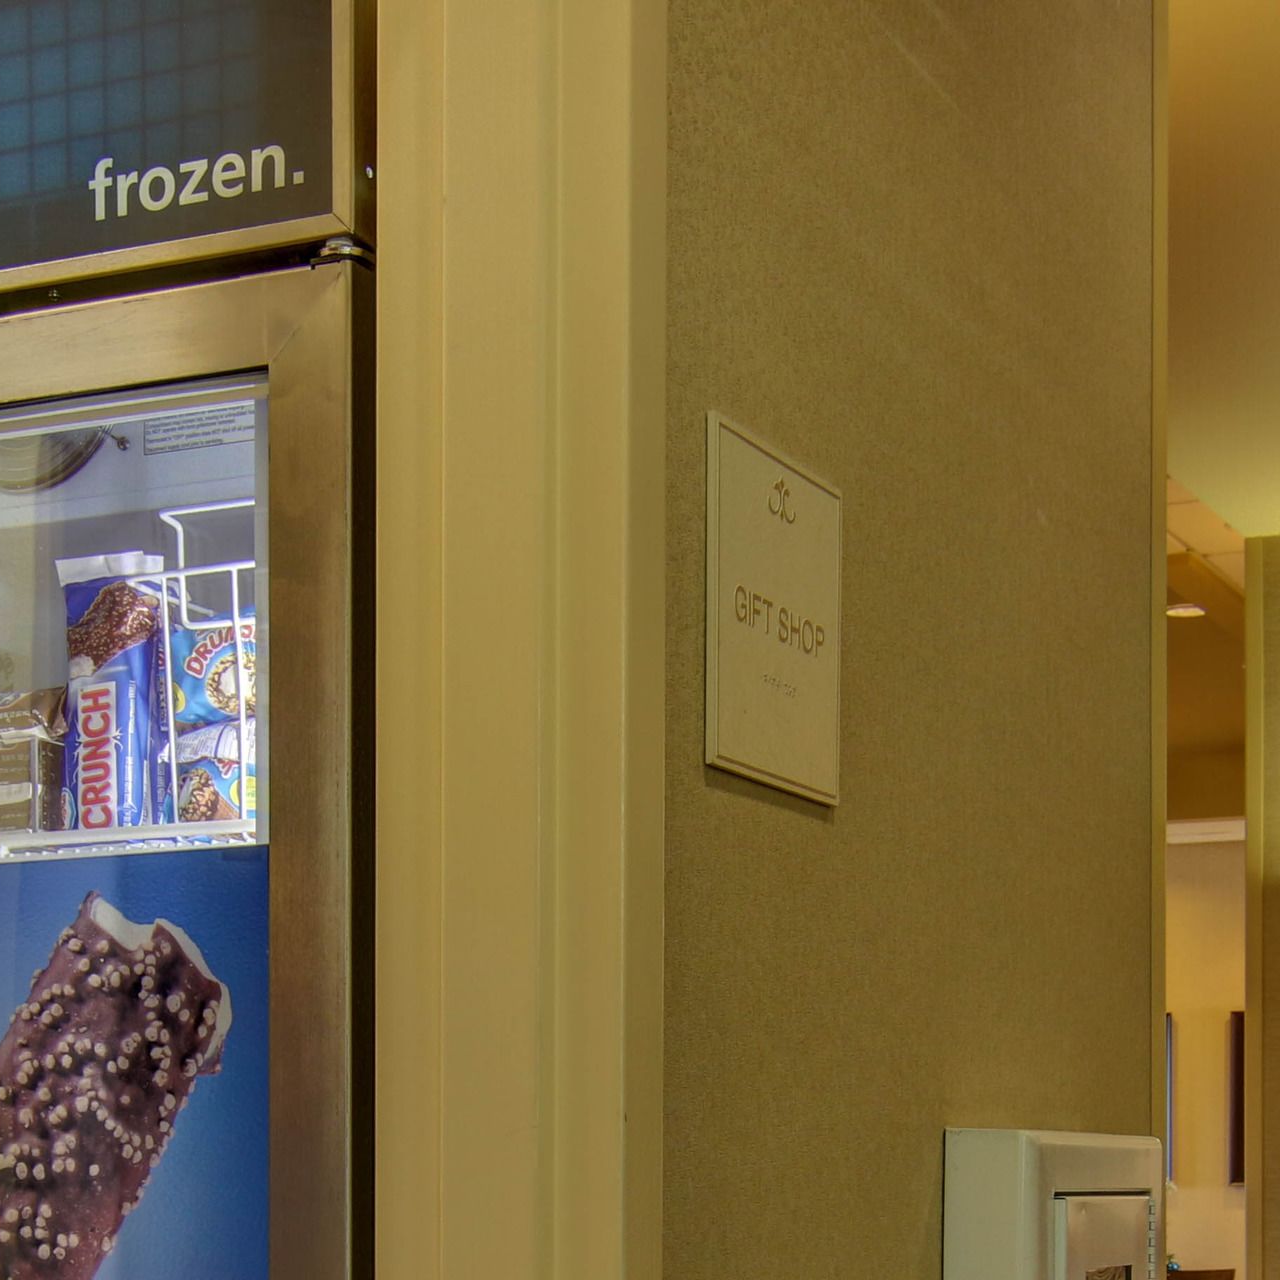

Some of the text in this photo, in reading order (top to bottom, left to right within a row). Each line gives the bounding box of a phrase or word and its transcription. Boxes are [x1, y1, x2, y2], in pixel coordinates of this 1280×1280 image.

[89, 144, 304, 221] frozen.
[733, 584, 825, 658] GIFT SHOP
[80, 687, 113, 830] CRUNCH
